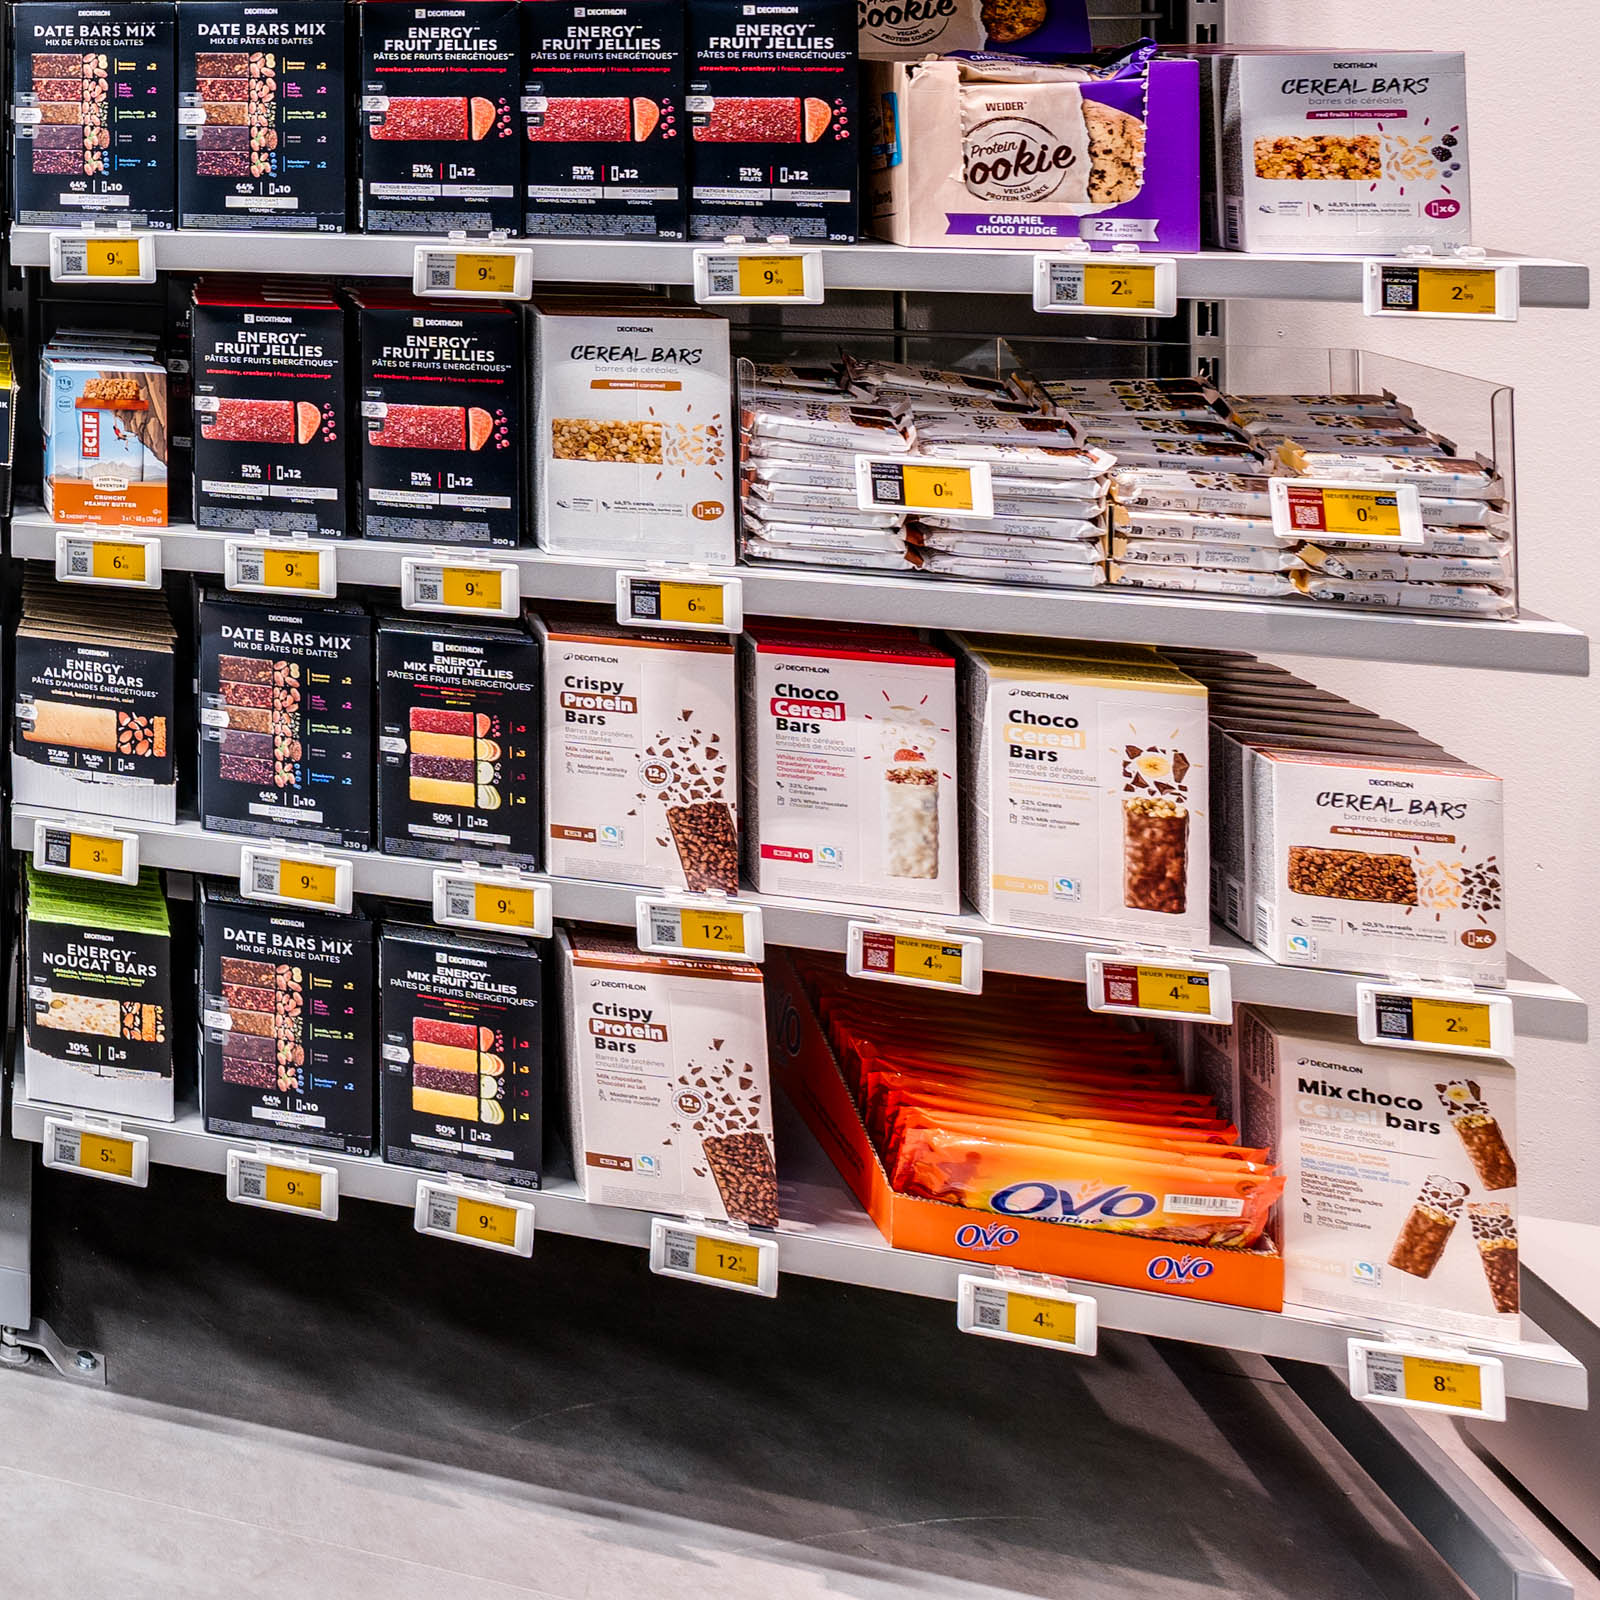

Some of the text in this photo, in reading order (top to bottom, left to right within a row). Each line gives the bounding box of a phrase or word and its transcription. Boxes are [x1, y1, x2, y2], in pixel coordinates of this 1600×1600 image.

[33, 25, 156, 38] DATE BARS MIX
[384, 38, 498, 52] FRUIT JELLIES
[1281, 77, 1429, 96] CEREAL BARS
[985, 102, 1025, 112] WEIDER
[1362, 95, 1404, 105] céréales
[970, 140, 1018, 159] Protein
[976, 224, 1058, 236] CHOCO FUDGE
[989, 215, 1044, 226] CARAMEL
[84, 414, 98, 448] CLIF
[221, 626, 352, 650] DATE BARS MIX
[575, 654, 618, 663] DECATHLON
[43, 666, 144, 688] ALMOND BARS
[564, 675, 624, 694] Crispy
[775, 683, 839, 701] Choco
[564, 693, 632, 712] Protein
[775, 702, 841, 720] Cereal
[565, 710, 606, 726] Bars
[776, 718, 820, 734] Bars
[1008, 709, 1079, 730] Choco
[1008, 727, 1082, 748] Cereal
[1009, 744, 1058, 763] Bars
[1298, 1077, 1424, 1112] Mix choco
[1300, 1100, 1441, 1136] Cereal bars
